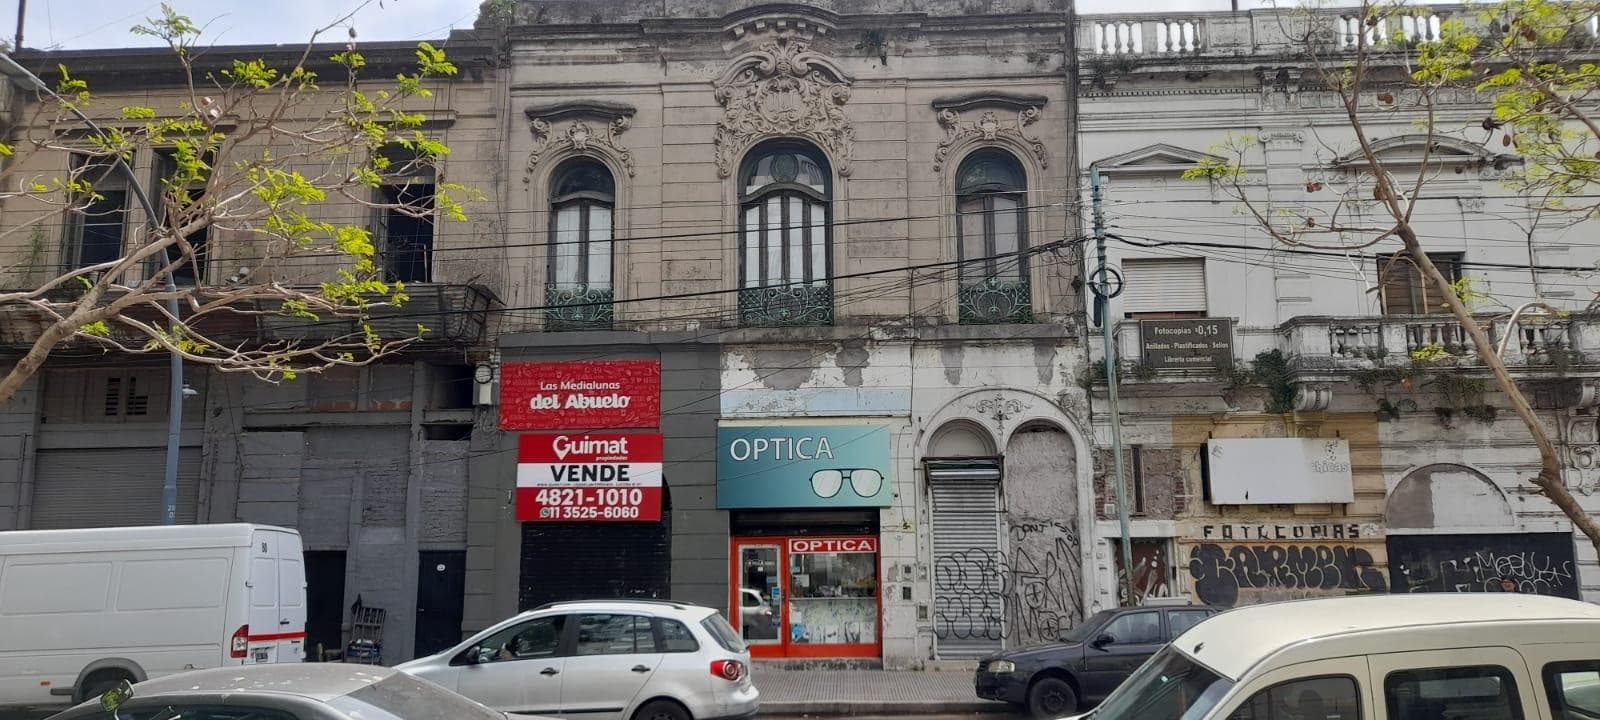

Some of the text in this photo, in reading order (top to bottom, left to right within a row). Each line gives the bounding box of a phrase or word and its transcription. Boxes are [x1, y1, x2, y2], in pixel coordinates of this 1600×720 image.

[1154, 326, 1192, 335] Fotocopias
[540, 381, 621, 391] Las Medialunas
[530, 392, 631, 410] del Abuelo
[552, 435, 629, 460] Guimat
[730, 437, 834, 461] OPTICA
[550, 464, 630, 482] VENDE
[535, 488, 643, 506] 4821-1010
[550, 506, 639, 519] 11 3525-6060
[793, 540, 873, 551] OPTICA
